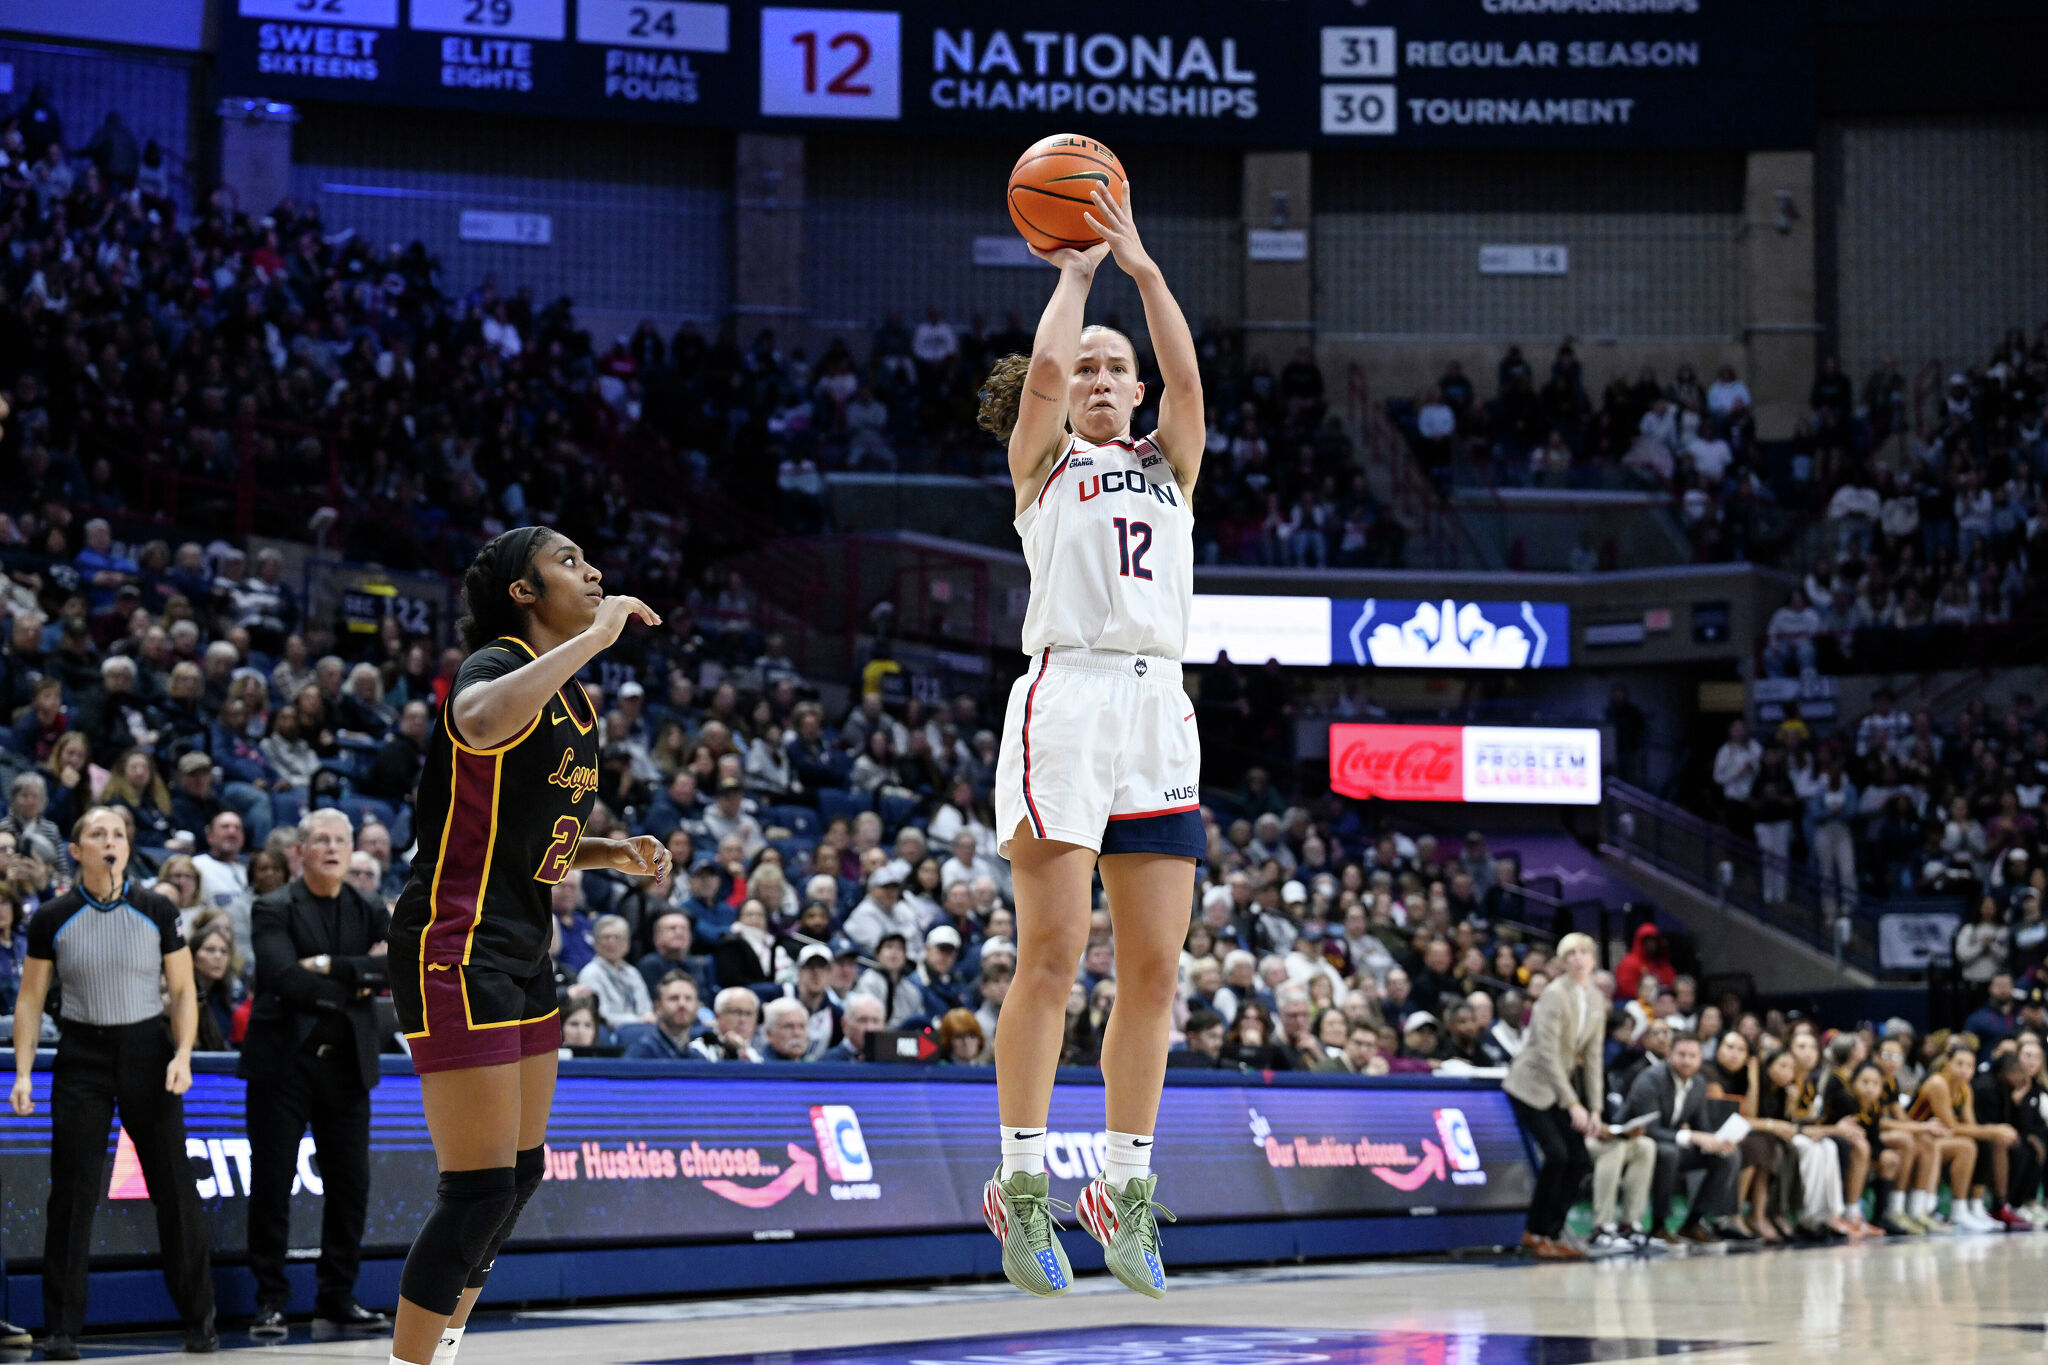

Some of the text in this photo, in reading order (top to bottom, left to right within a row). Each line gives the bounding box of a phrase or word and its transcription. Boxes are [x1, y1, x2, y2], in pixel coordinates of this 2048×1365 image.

[628, 8, 677, 38] 24
[258, 22, 380, 57] SWEET
[440, 37, 533, 69] ELITE
[1340, 37, 1379, 67] 31
[1405, 41, 1699, 68] REGULAR SEASON
[257, 52, 380, 82] SIXTEENS
[605, 49, 697, 77] FINAL
[792, 31, 872, 96] 12
[932, 28, 1256, 83] NATIONAL
[440, 64, 534, 92] EIGHTS
[604, 75, 699, 103] FOURS
[930, 79, 1259, 119] CHAMPIONSHIPS
[1334, 95, 1384, 124] 30
[1407, 99, 1634, 125] TOURNAMENT
[1050, 137, 1113, 163] ELITE
[1069, 459, 1094, 469] CHANGE
[1112, 516, 1153, 581] 12
[1476, 750, 1586, 768] PROBLEM
[533, 814, 588, 885] 2
[581, 1140, 678, 1180] Huskies
